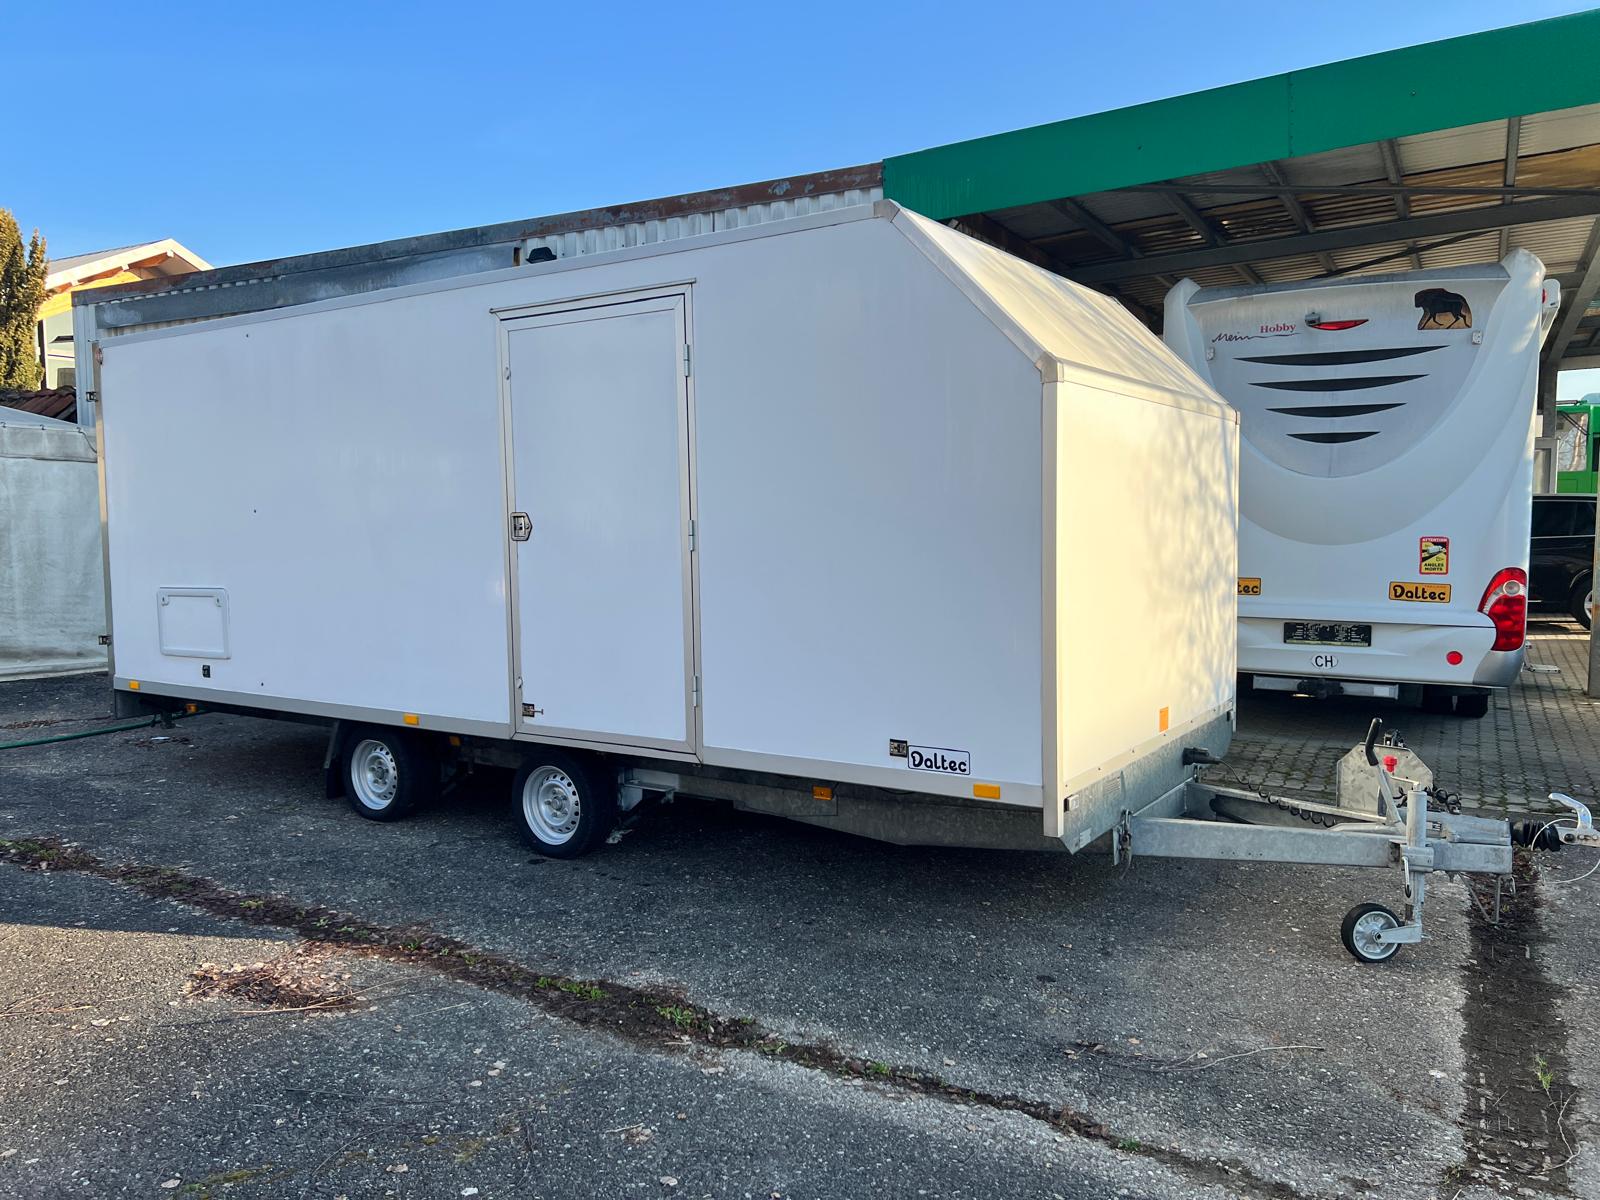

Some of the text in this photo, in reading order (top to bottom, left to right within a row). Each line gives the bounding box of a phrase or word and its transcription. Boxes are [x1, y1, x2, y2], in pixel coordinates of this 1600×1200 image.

[1211, 323, 1296, 343] Mein Hobby
[1393, 584, 1446, 601] Daltec
[1315, 655, 1334, 668] CH
[911, 750, 967, 773] Daltec
